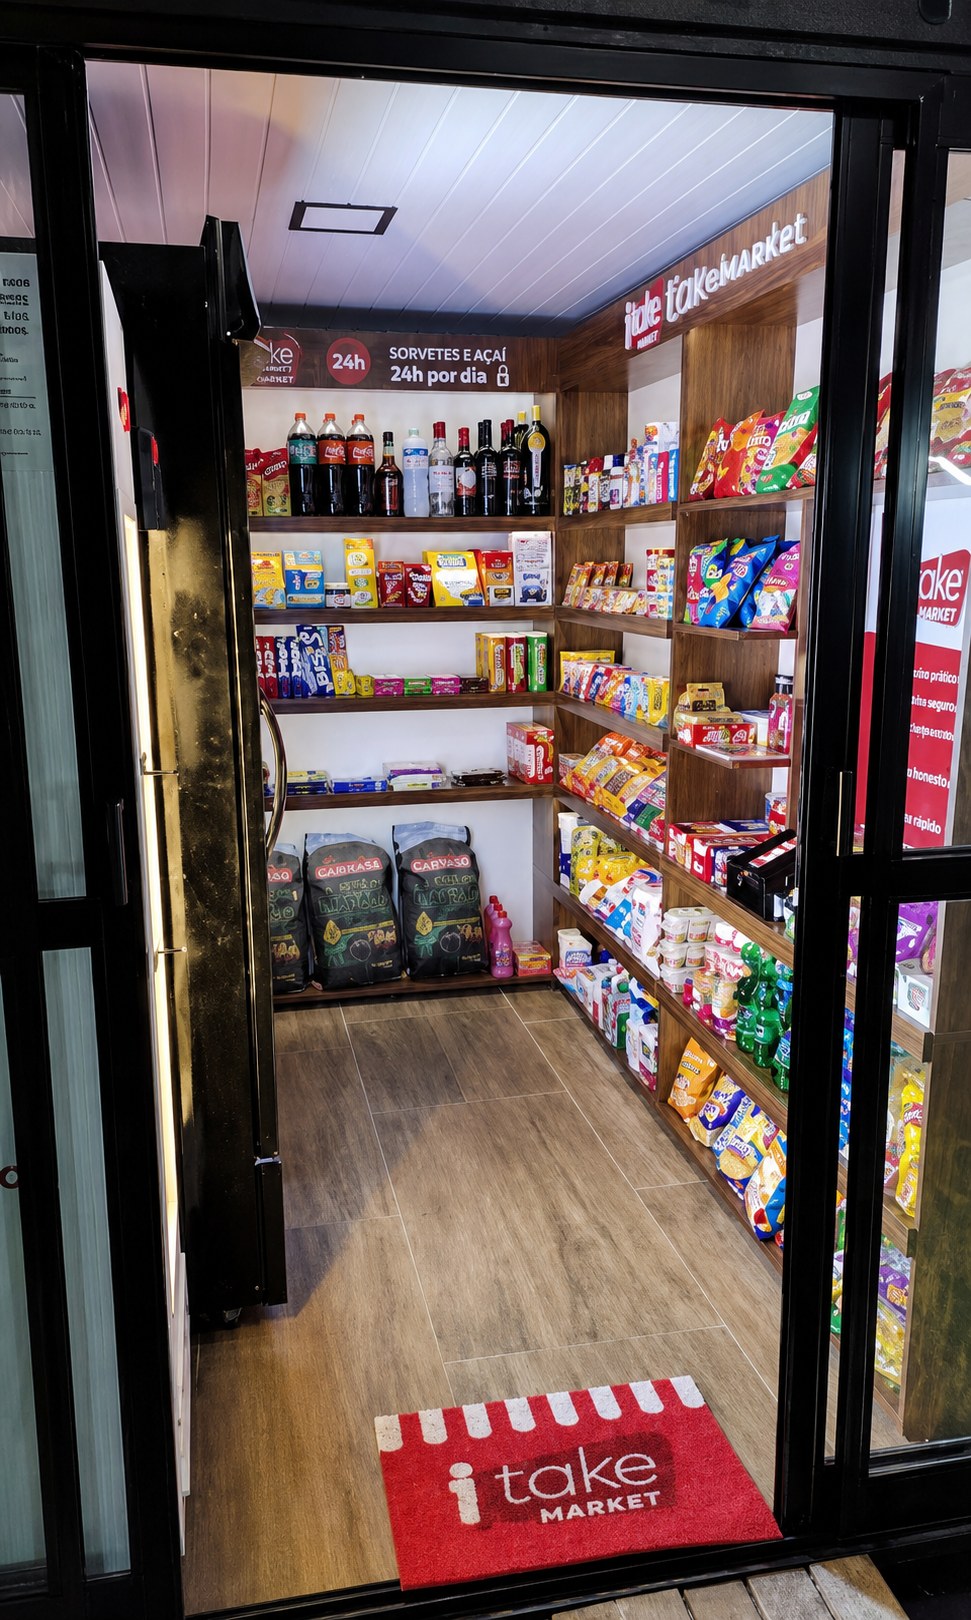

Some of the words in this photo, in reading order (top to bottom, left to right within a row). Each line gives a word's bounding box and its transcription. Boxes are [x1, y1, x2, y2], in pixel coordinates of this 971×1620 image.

[332, 353, 366, 370] 24h
[389, 347, 460, 361] SORVETES
[463, 349, 471, 361] E
[473, 347, 507, 365] AÇAÍ
[390, 365, 423, 382] 24h
[427, 369, 457, 387] por
[460, 366, 487, 384] dia
[919, 555, 964, 602] ake
[919, 606, 957, 622] MARKET
[930, 670, 957, 684] prático
[927, 699, 954, 713] seguro
[913, 766, 947, 788] honesto
[913, 815, 941, 835] rápido
[494, 1446, 658, 1505] take
[540, 1490, 661, 1523] MARKET
